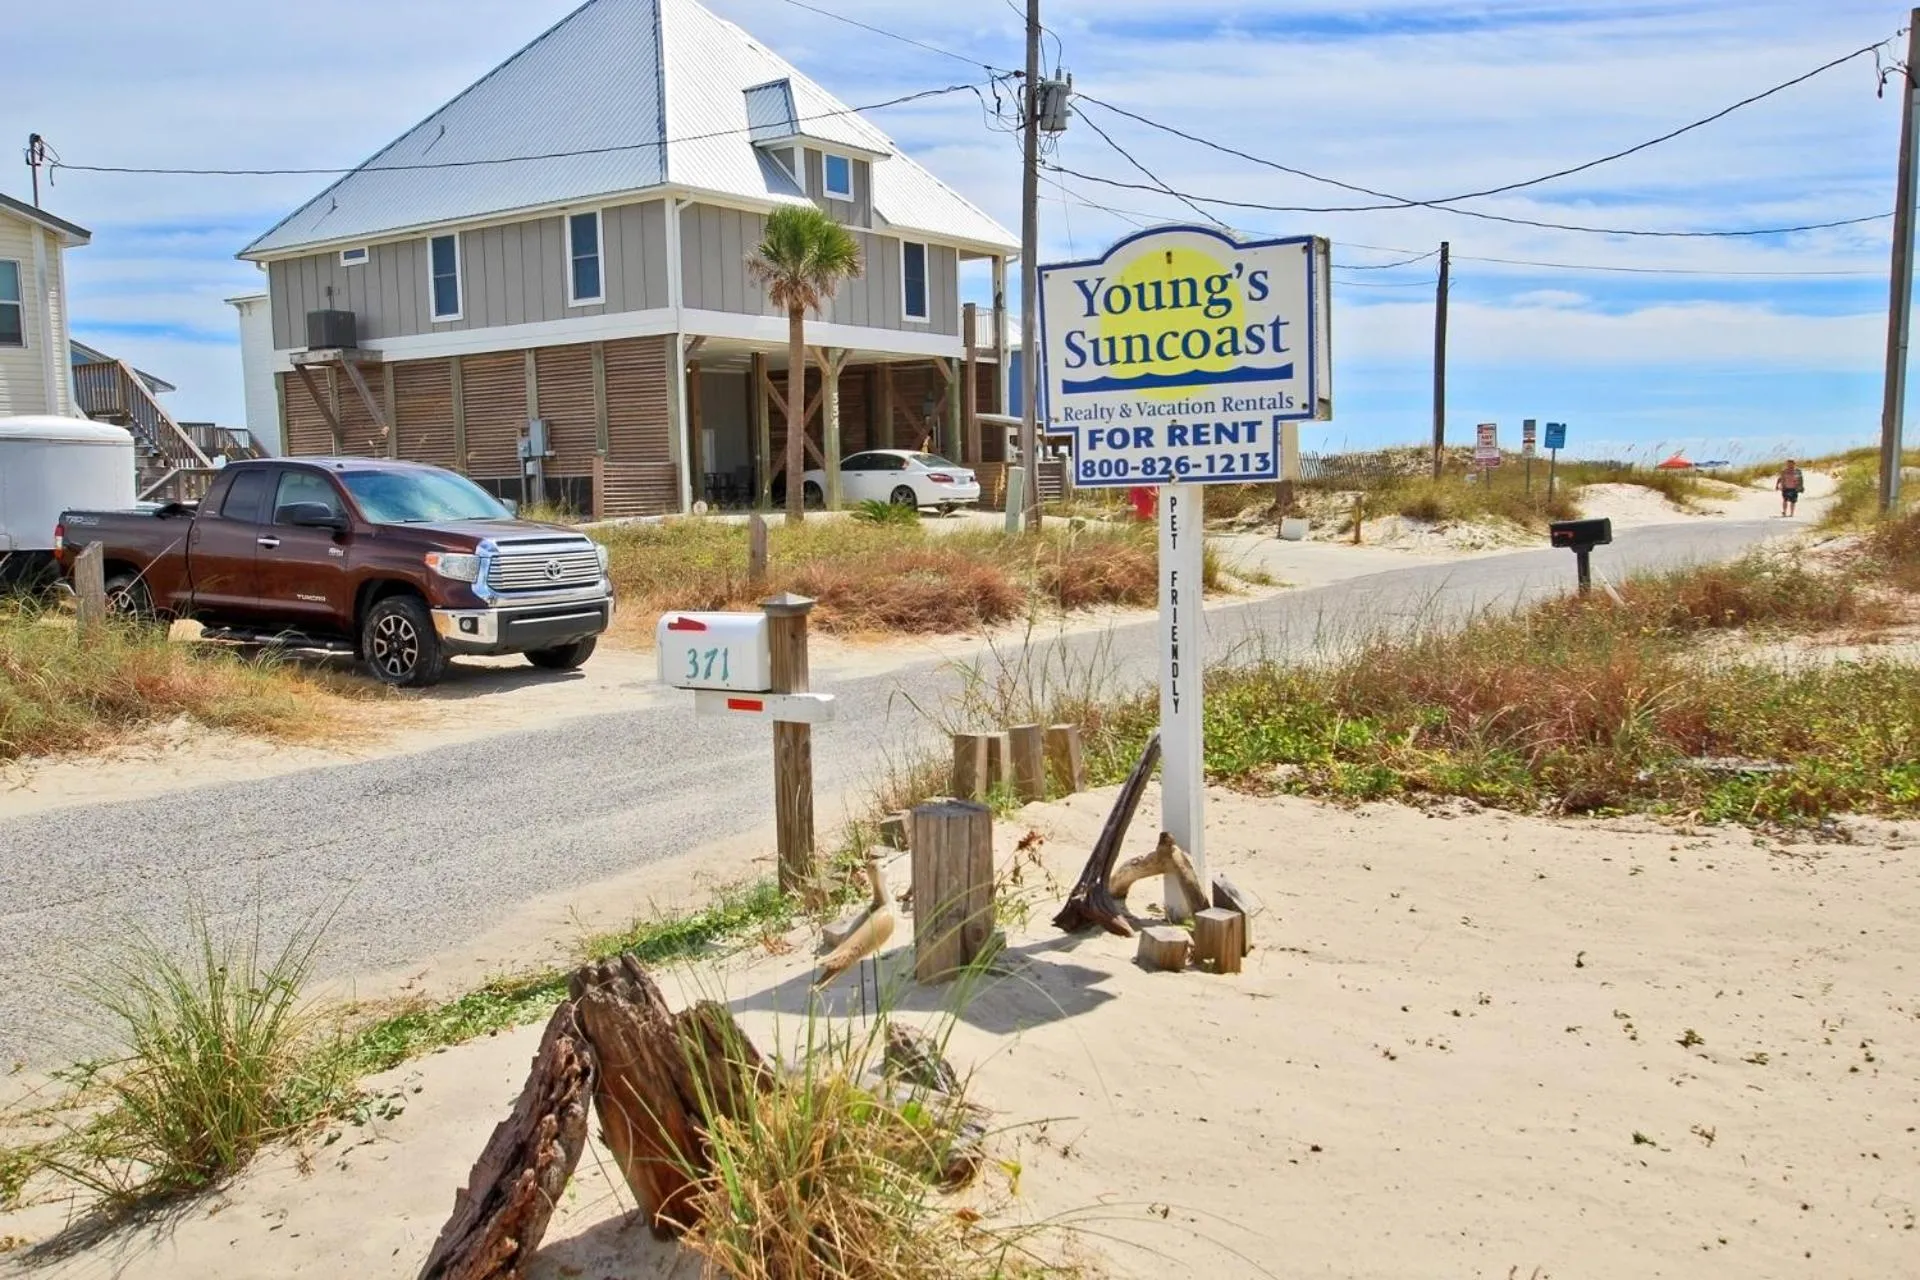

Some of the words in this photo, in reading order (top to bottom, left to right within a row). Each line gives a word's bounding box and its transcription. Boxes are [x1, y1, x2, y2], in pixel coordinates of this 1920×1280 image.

[1073, 262, 1269, 319] Young's
[1064, 315, 1290, 369] Suncoast
[1064, 403, 1115, 423] Realty
[1119, 402, 1132, 418] &
[1136, 397, 1216, 417] Vacation
[1221, 391, 1294, 413] Rentals
[1088, 426, 1155, 451] FOR
[1167, 420, 1263, 447] RENT
[1081, 452, 1271, 478] 800-826-1213
[1169, 496, 1178, 550] PET
[685, 647, 730, 681] 371
[1170, 570, 1180, 714] FRIENDLY
